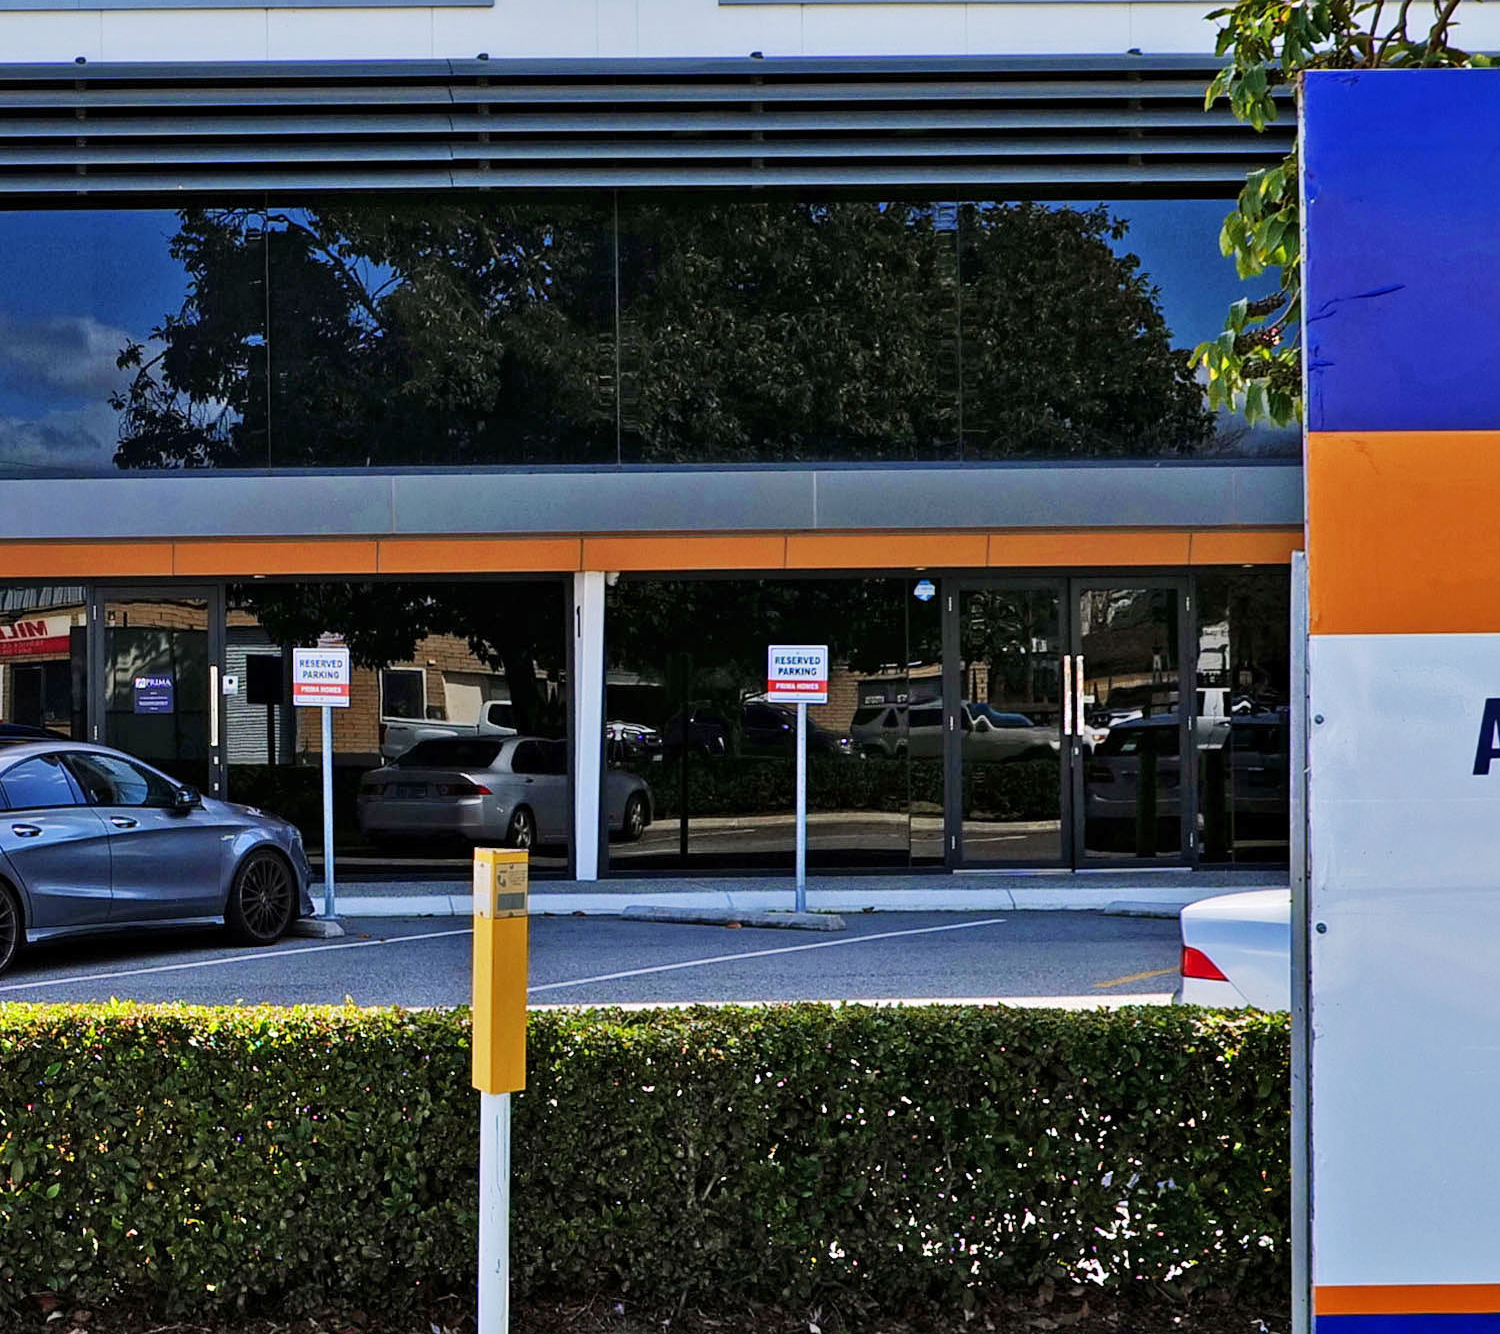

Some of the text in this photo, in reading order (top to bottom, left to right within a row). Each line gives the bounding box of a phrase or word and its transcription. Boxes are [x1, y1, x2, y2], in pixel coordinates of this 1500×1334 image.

[299, 659, 343, 668] RESERVED
[775, 656, 821, 665] RESERVED
[303, 670, 340, 679] PARKING
[778, 667, 817, 676] PARKING
